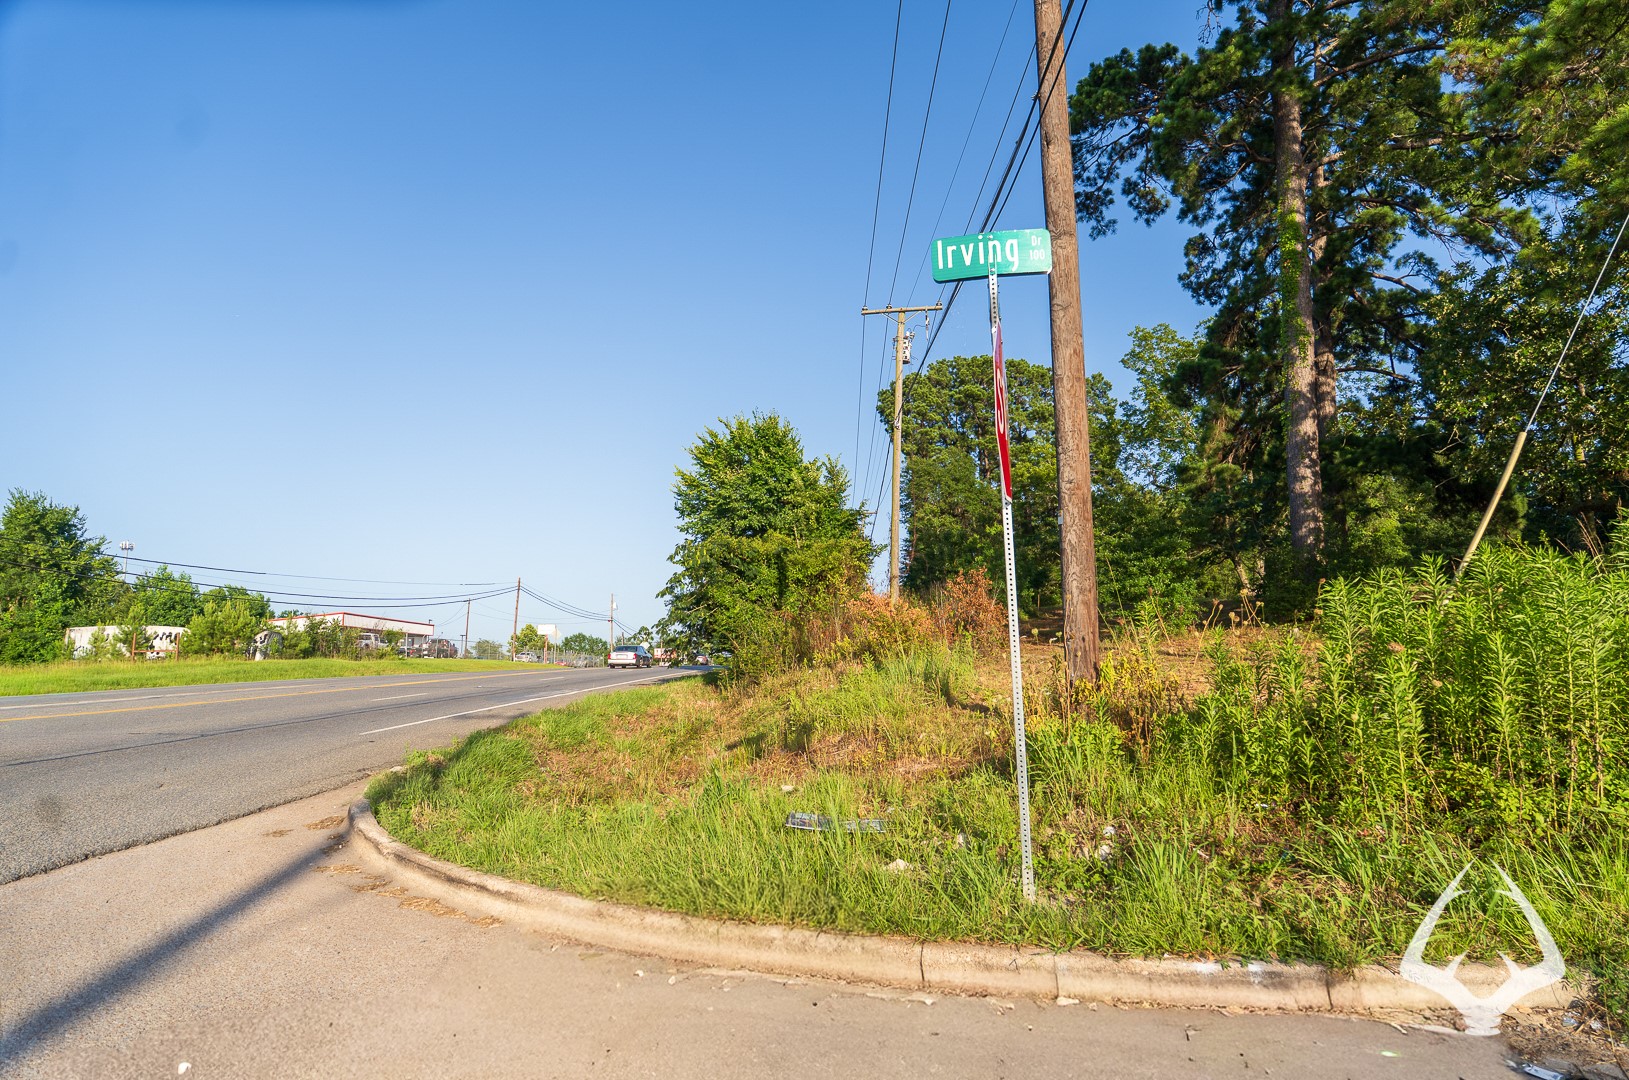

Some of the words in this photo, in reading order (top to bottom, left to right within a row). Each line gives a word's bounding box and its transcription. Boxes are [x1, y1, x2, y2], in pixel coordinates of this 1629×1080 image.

[937, 235, 1019, 272] Irving
[1031, 235, 1042, 246] Dr
[1029, 249, 1045, 260] 100
